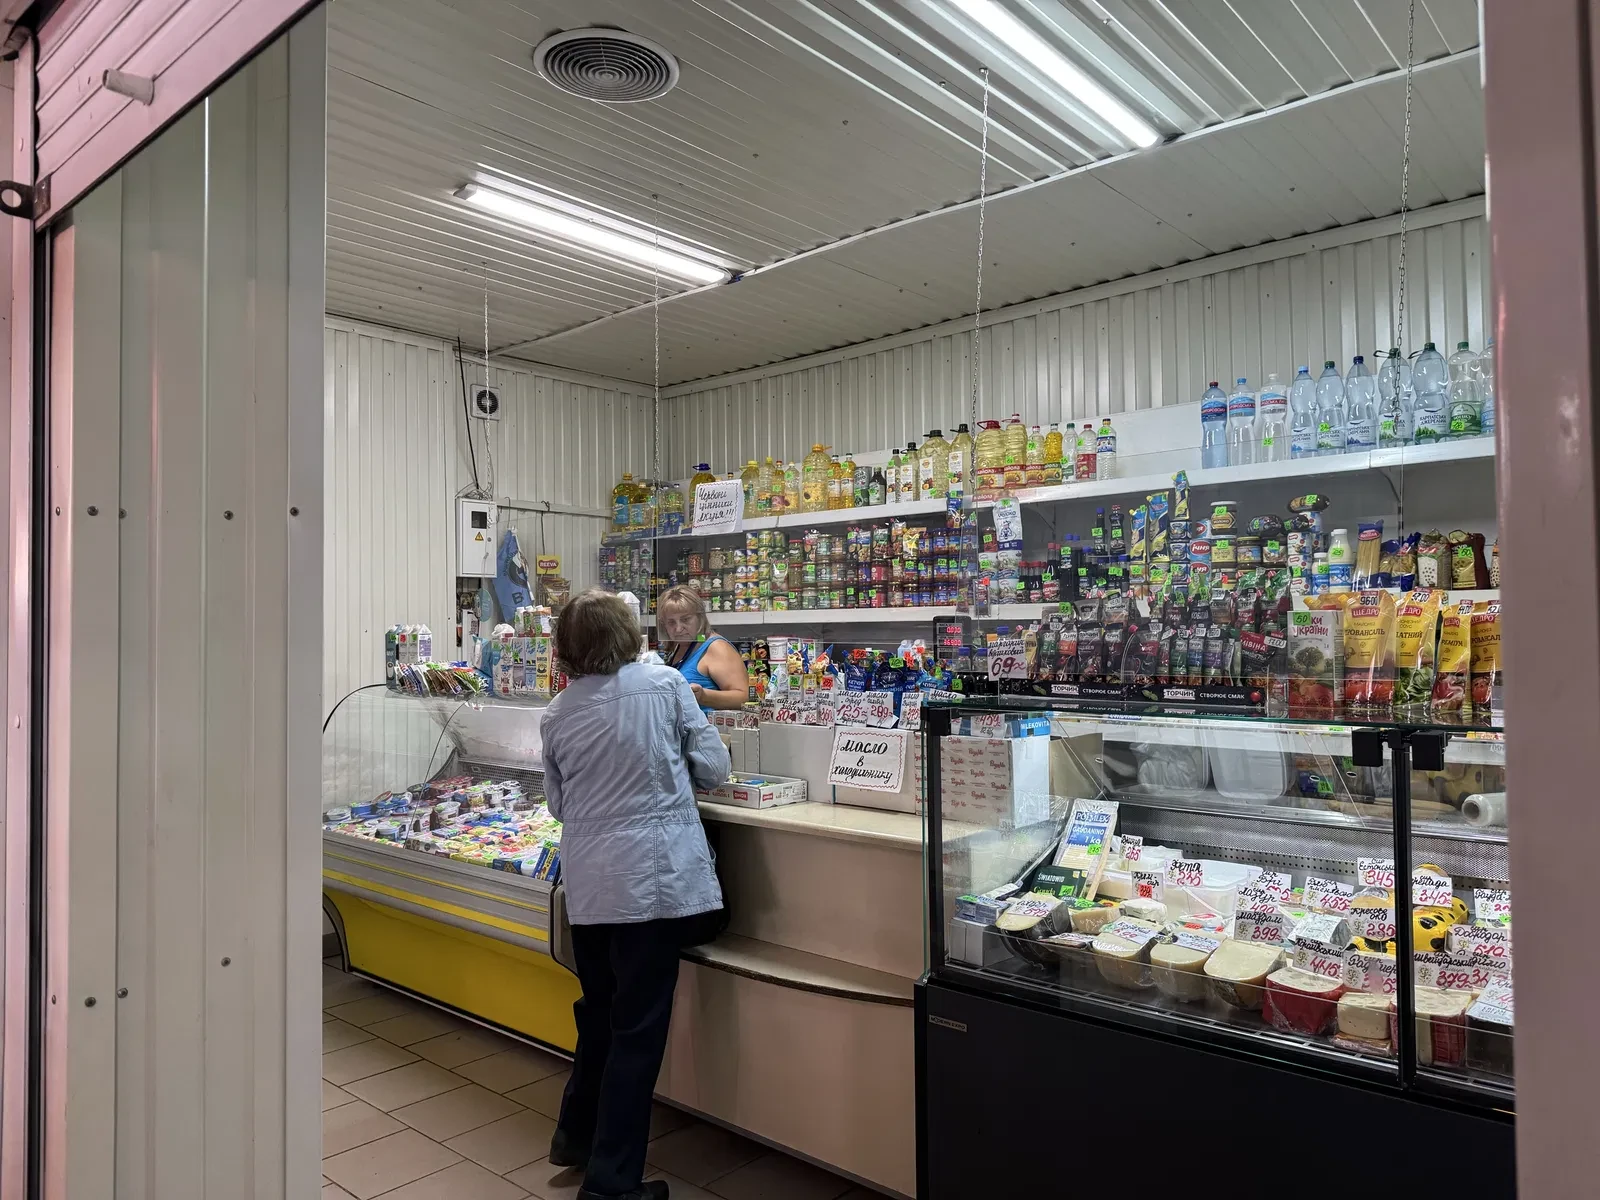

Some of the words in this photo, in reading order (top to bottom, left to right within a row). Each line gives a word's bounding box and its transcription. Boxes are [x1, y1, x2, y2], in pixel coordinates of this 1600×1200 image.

[1353, 607, 1380, 617] ЩЕДРО
[1053, 685, 1078, 693] ТОРЧИН
[1166, 690, 1195, 698] ТОРЧИН
[856, 755, 865, 767] в
